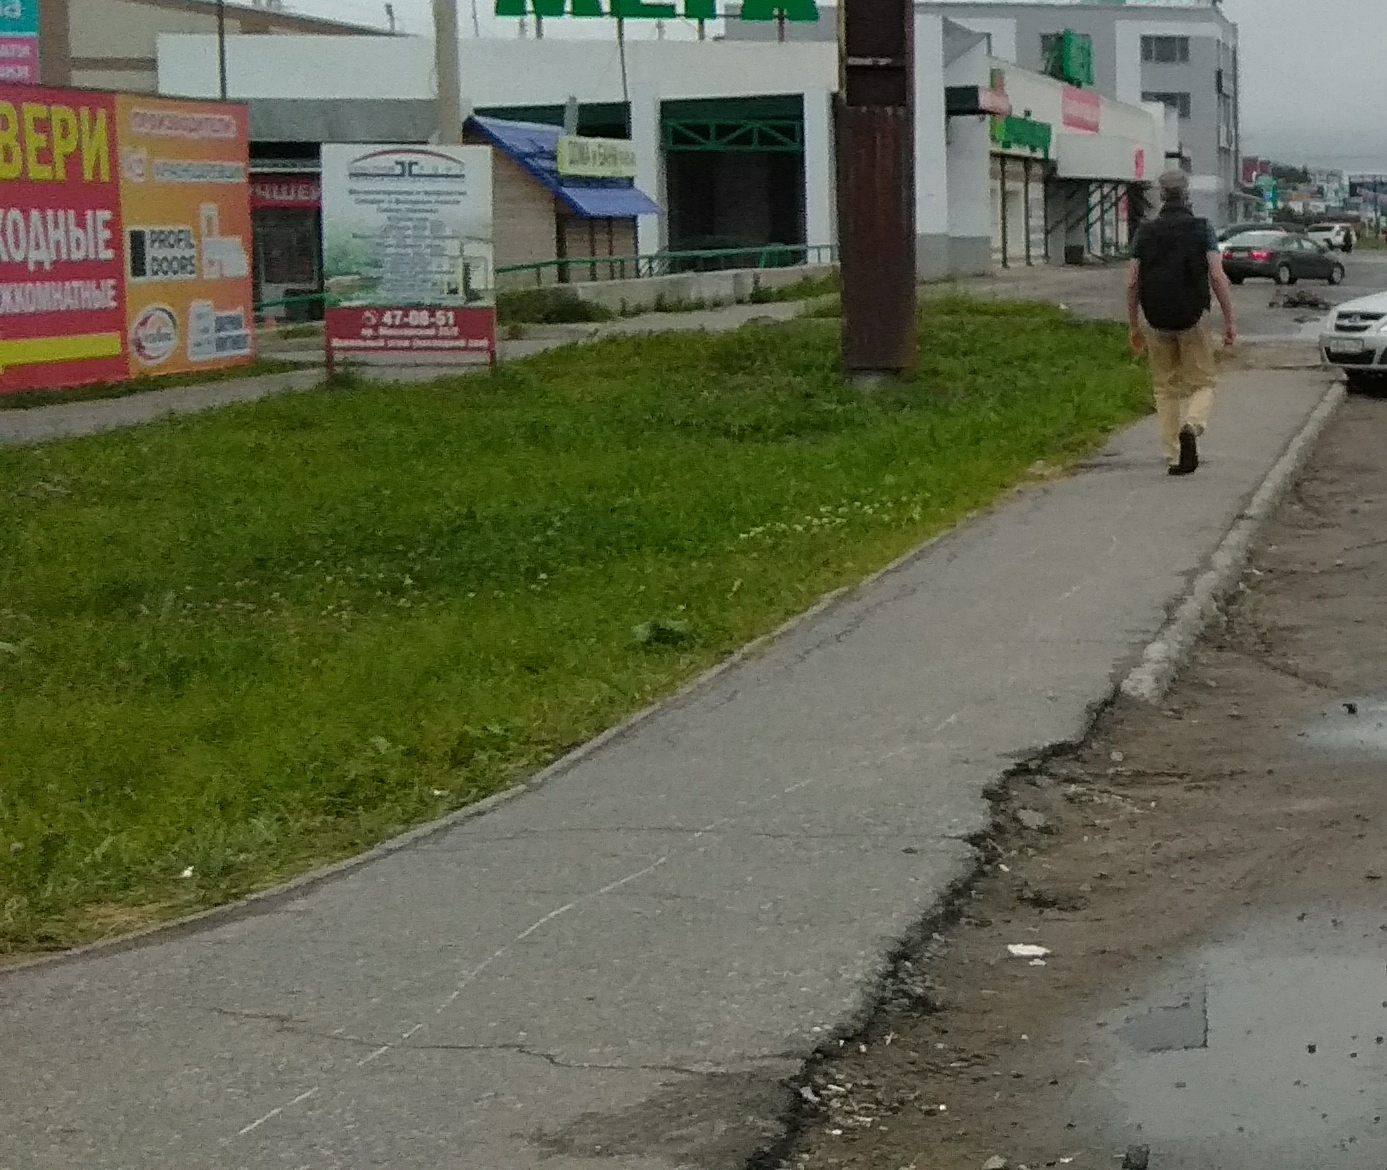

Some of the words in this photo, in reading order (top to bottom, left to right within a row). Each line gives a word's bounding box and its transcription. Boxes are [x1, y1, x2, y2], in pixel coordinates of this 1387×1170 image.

[150, 229, 195, 249] PROFIL
[151, 255, 196, 276] DOORS
[381, 309, 455, 327] 47-08-51
